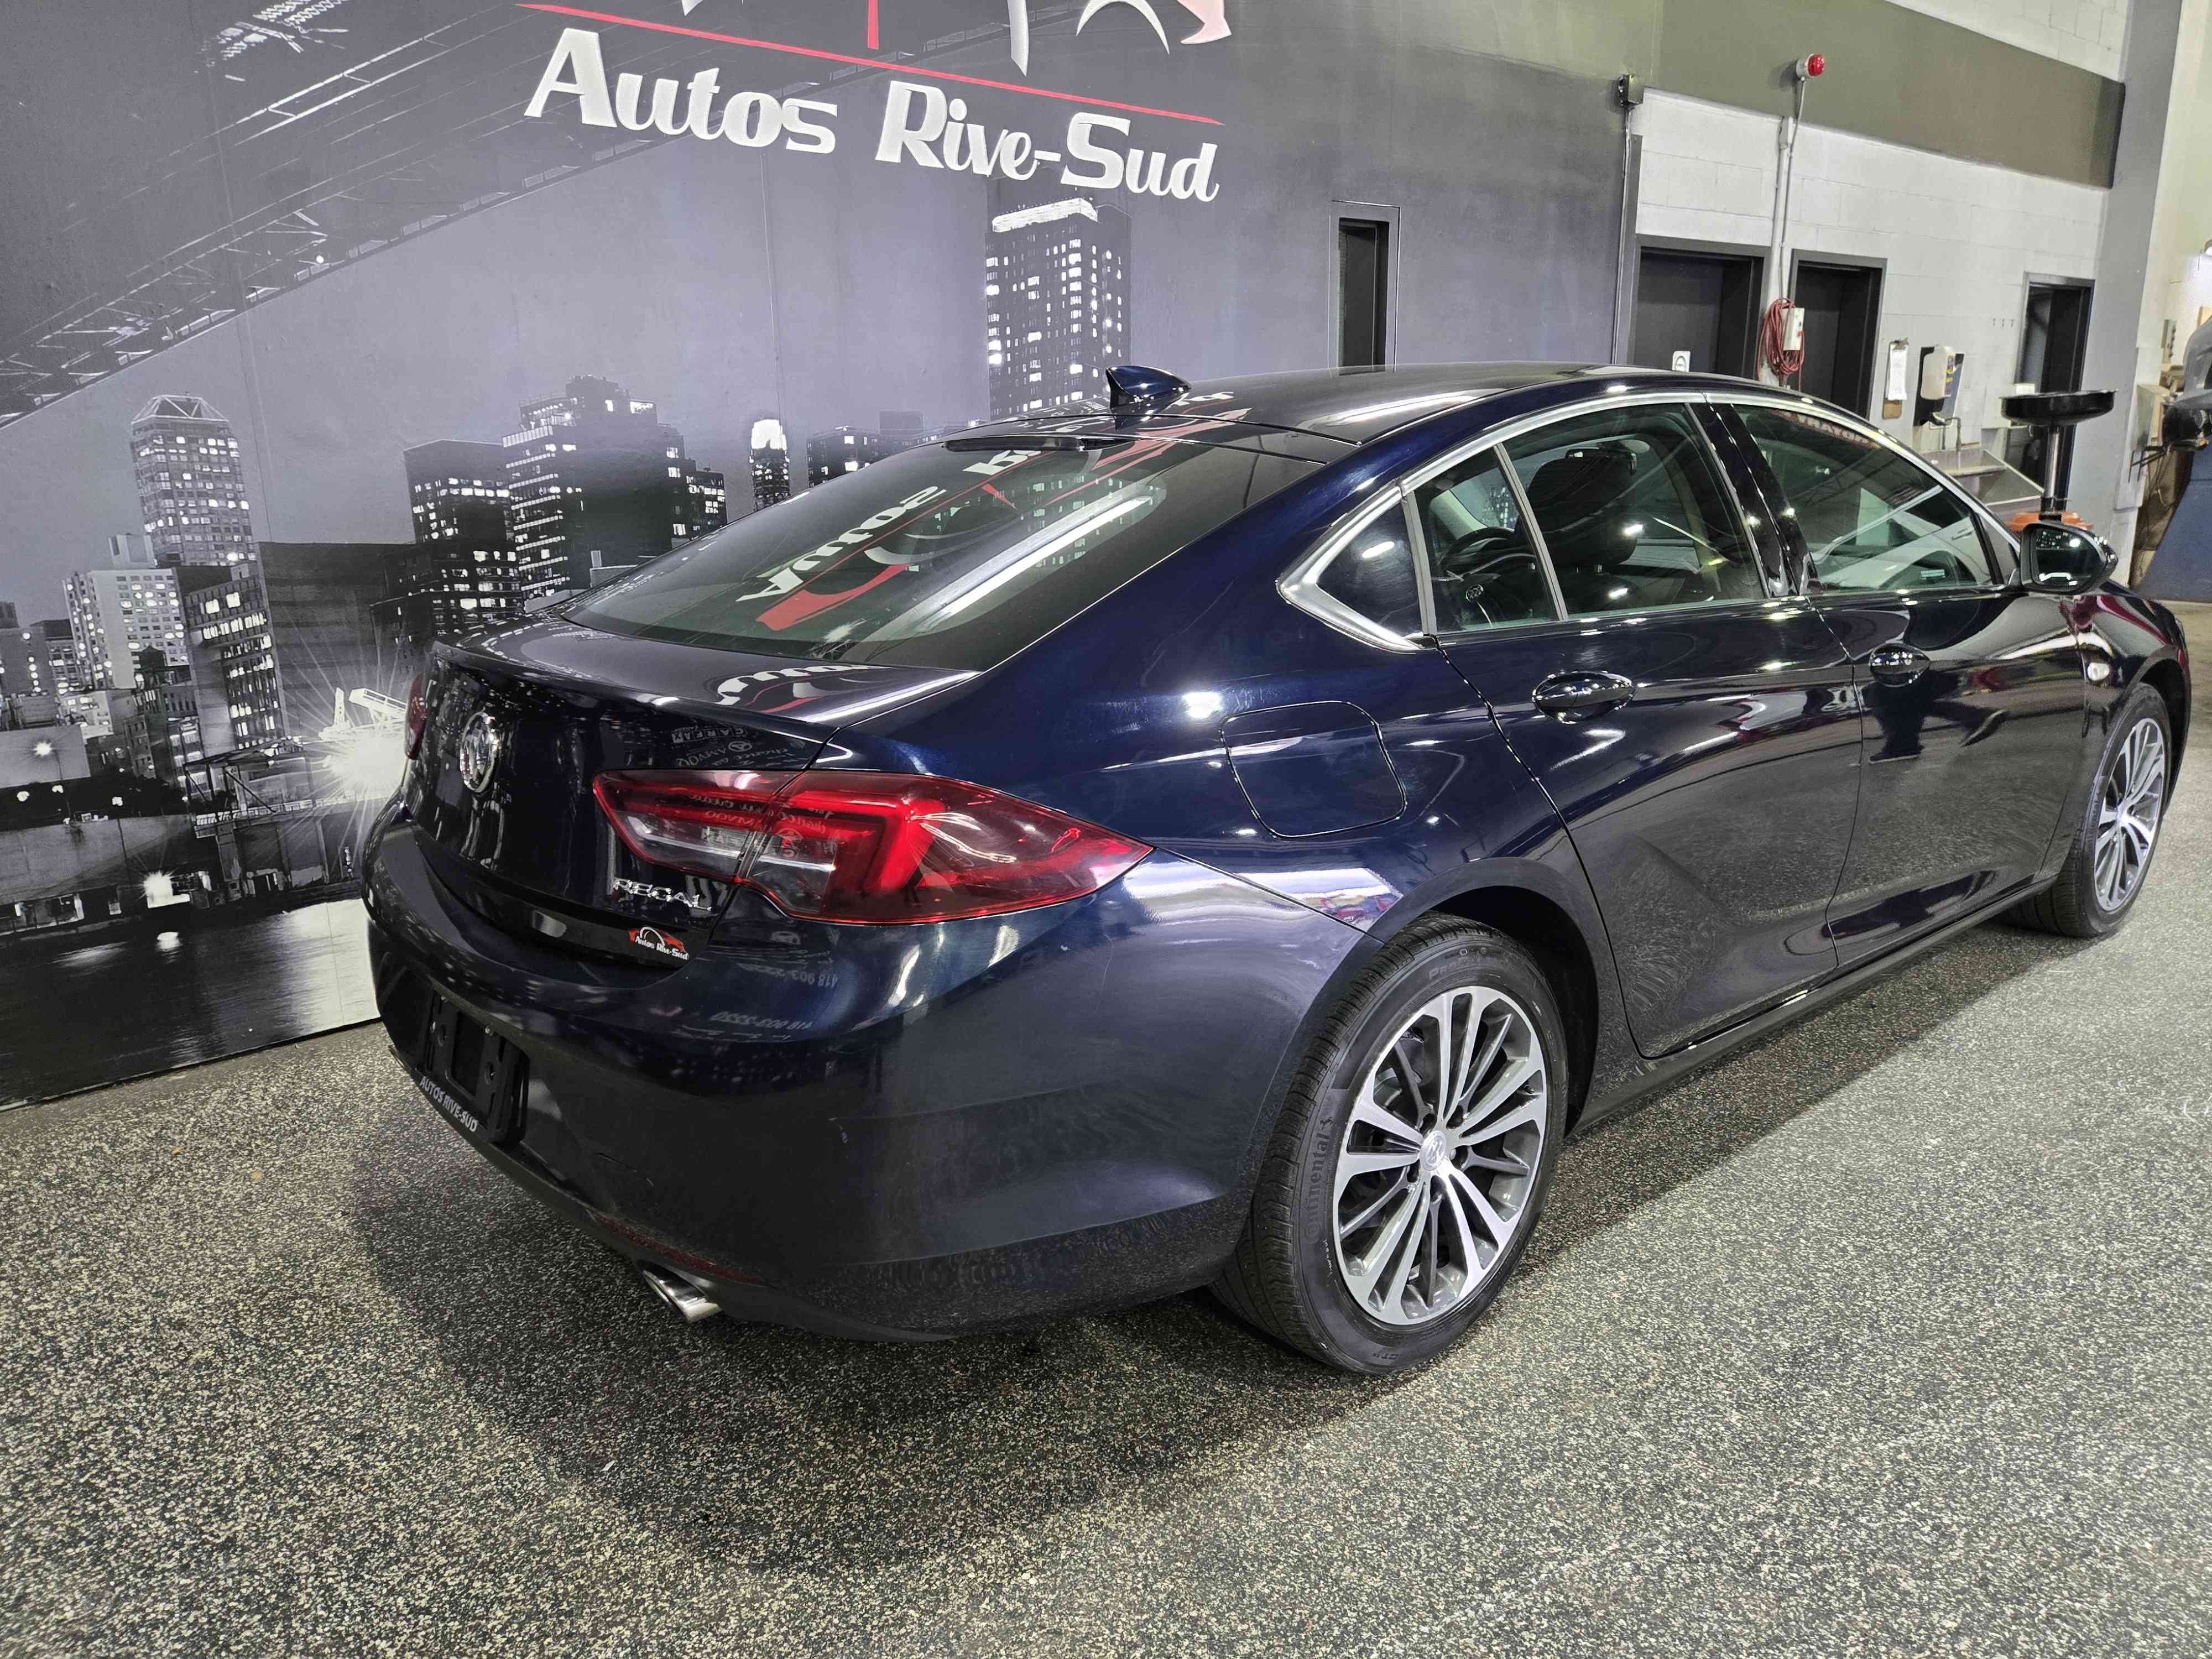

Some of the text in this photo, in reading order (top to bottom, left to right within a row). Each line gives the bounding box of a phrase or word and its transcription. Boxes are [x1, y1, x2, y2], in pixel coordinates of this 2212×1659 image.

[524, 27, 1221, 202] Autos Rive-Sud
[613, 877, 712, 912] REGAL
[420, 1076, 478, 1133] AUTOS RIVE-SUD
